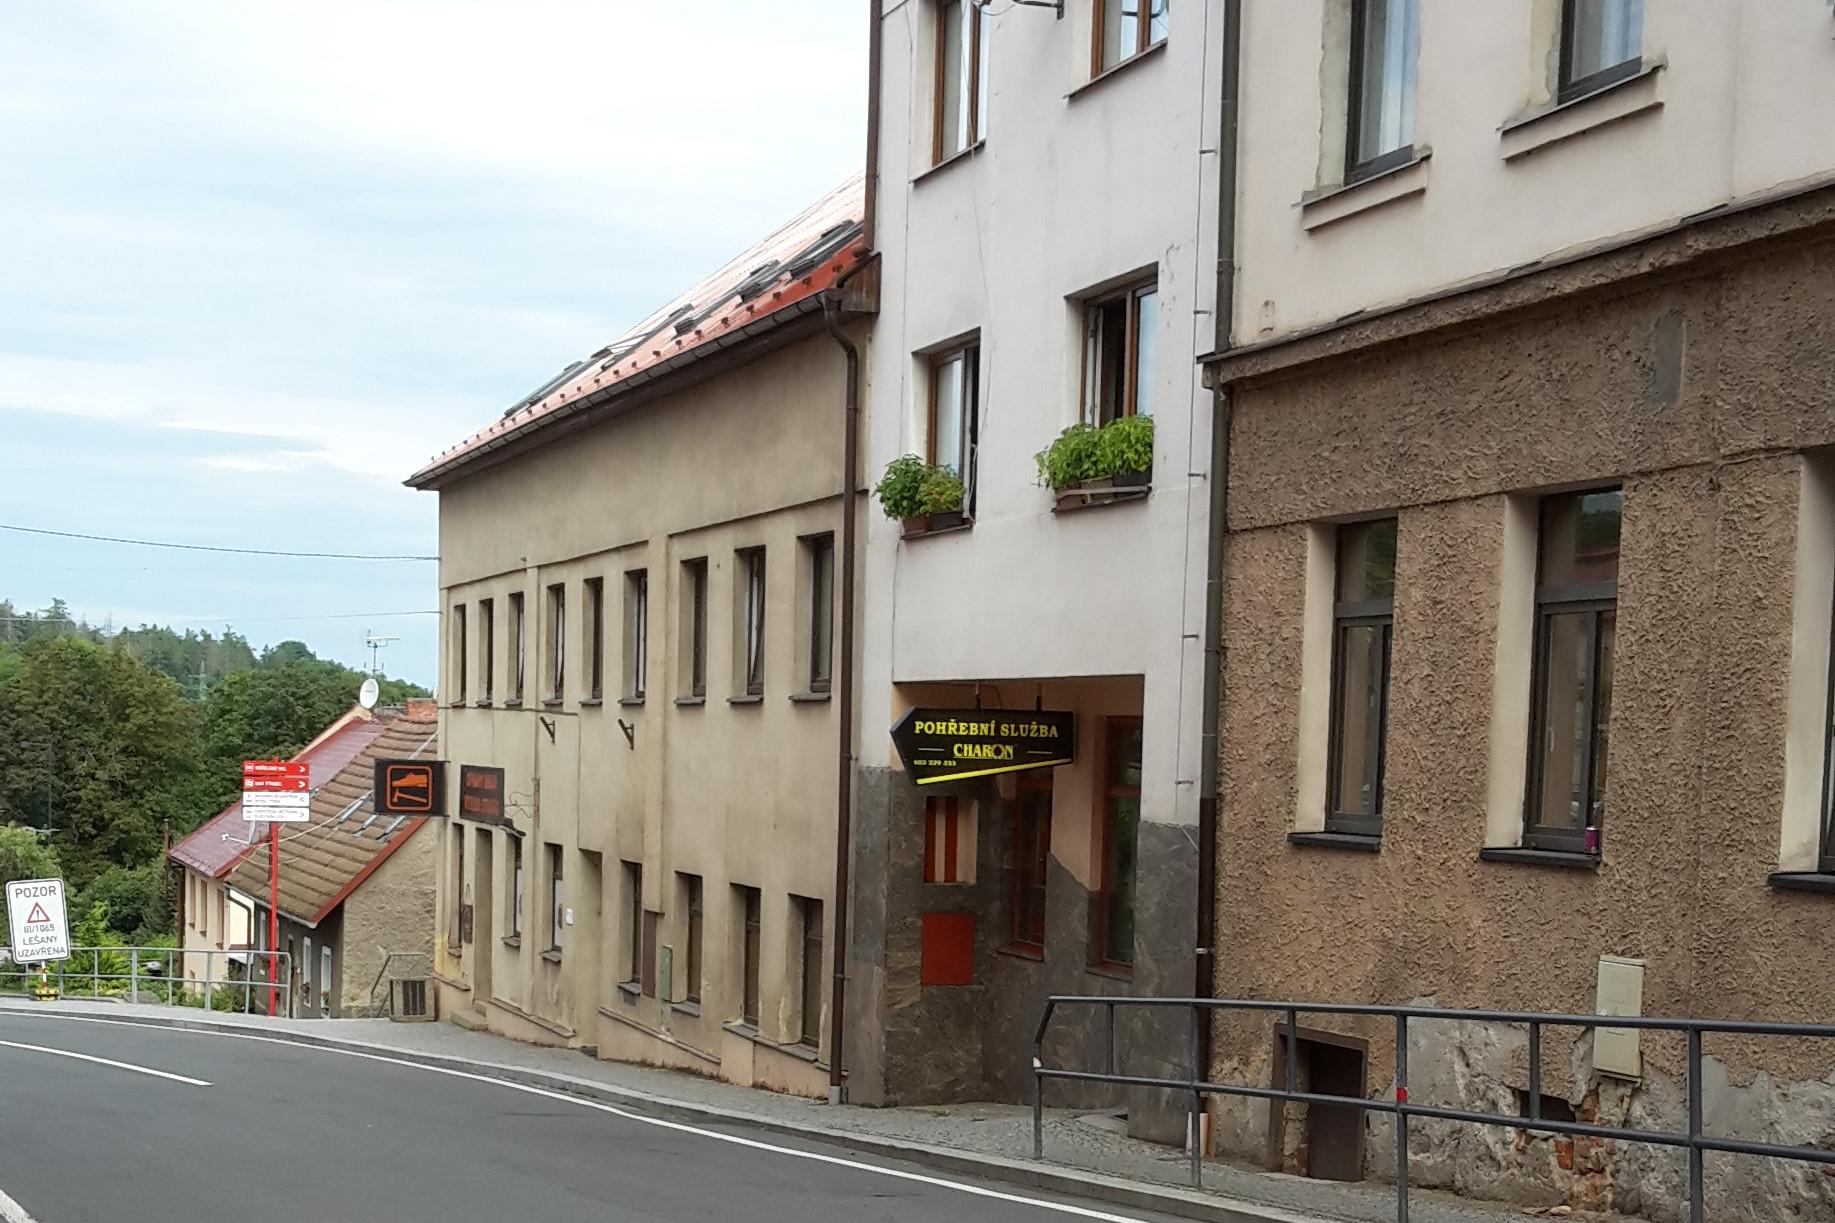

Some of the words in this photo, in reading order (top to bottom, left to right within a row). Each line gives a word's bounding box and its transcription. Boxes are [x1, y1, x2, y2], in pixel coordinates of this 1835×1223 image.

[914, 719, 996, 736] POHŘEBNÍ
[1000, 721, 1059, 738] SLUŽBA
[953, 743, 1014, 760] CHARON
[15, 885, 57, 899] POZOR
[22, 935, 58, 946] LEŠANY
[17, 946, 66, 958] UZAVŘENA
